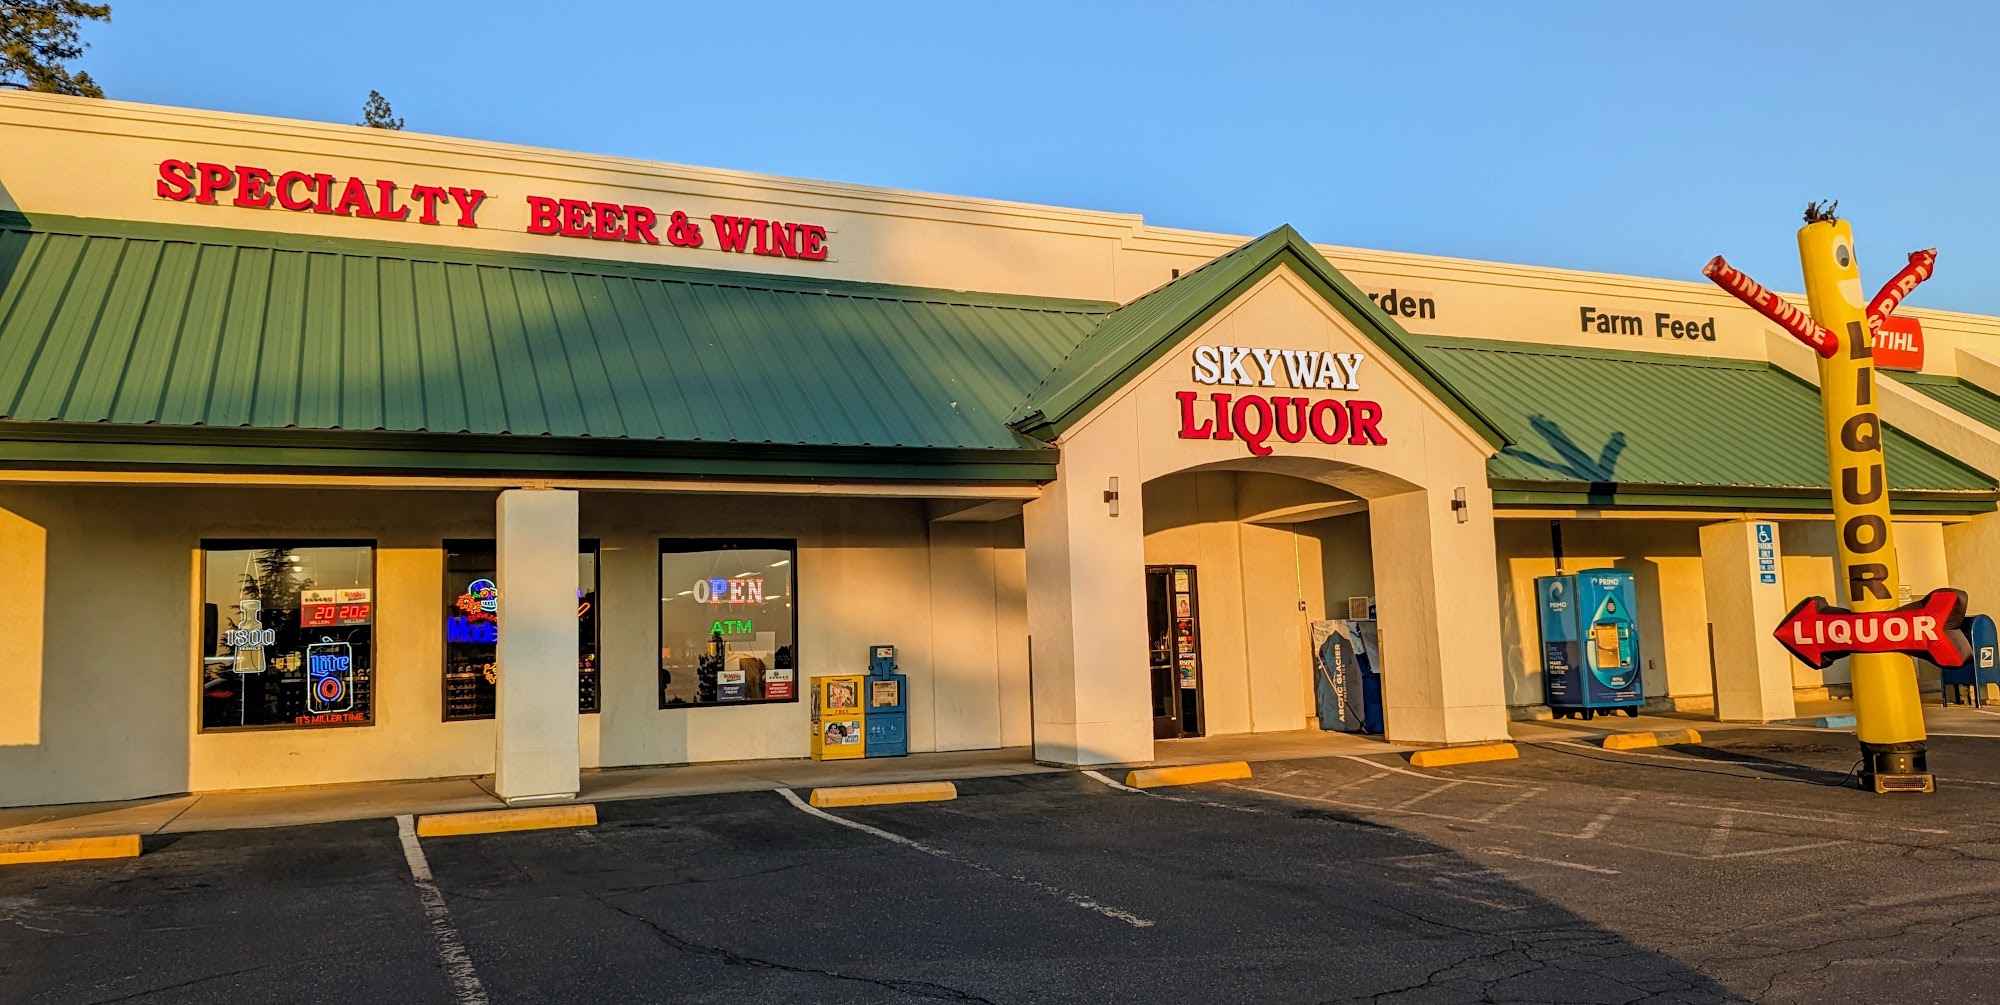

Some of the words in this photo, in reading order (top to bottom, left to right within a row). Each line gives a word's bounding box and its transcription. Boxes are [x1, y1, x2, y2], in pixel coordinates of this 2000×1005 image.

[156, 159, 486, 228] SPECIALTY
[527, 195, 658, 244] BEER
[667, 210, 702, 247] &
[711, 214, 829, 260] WINE
[1580, 306, 1643, 336] Farm
[1655, 312, 1717, 342] Feed
[1772, 298, 1827, 346] WINE
[1192, 345, 1365, 391] SKYWAY
[1176, 391, 1388, 457] LIQUOR
[1840, 320, 1893, 602] LIQUOR
[693, 578, 764, 605] OPEN
[1598, 578, 1619, 586] PRIMO
[314, 606, 335, 620] 20
[339, 605, 370, 619] 202
[709, 619, 753, 635] ATM
[225, 628, 276, 646] 1800
[1793, 615, 1939, 645] LIQUOR
[1334, 643, 1343, 685] GLACIER
[311, 714, 343, 724] MILLER
[343, 712, 365, 721] TIME
